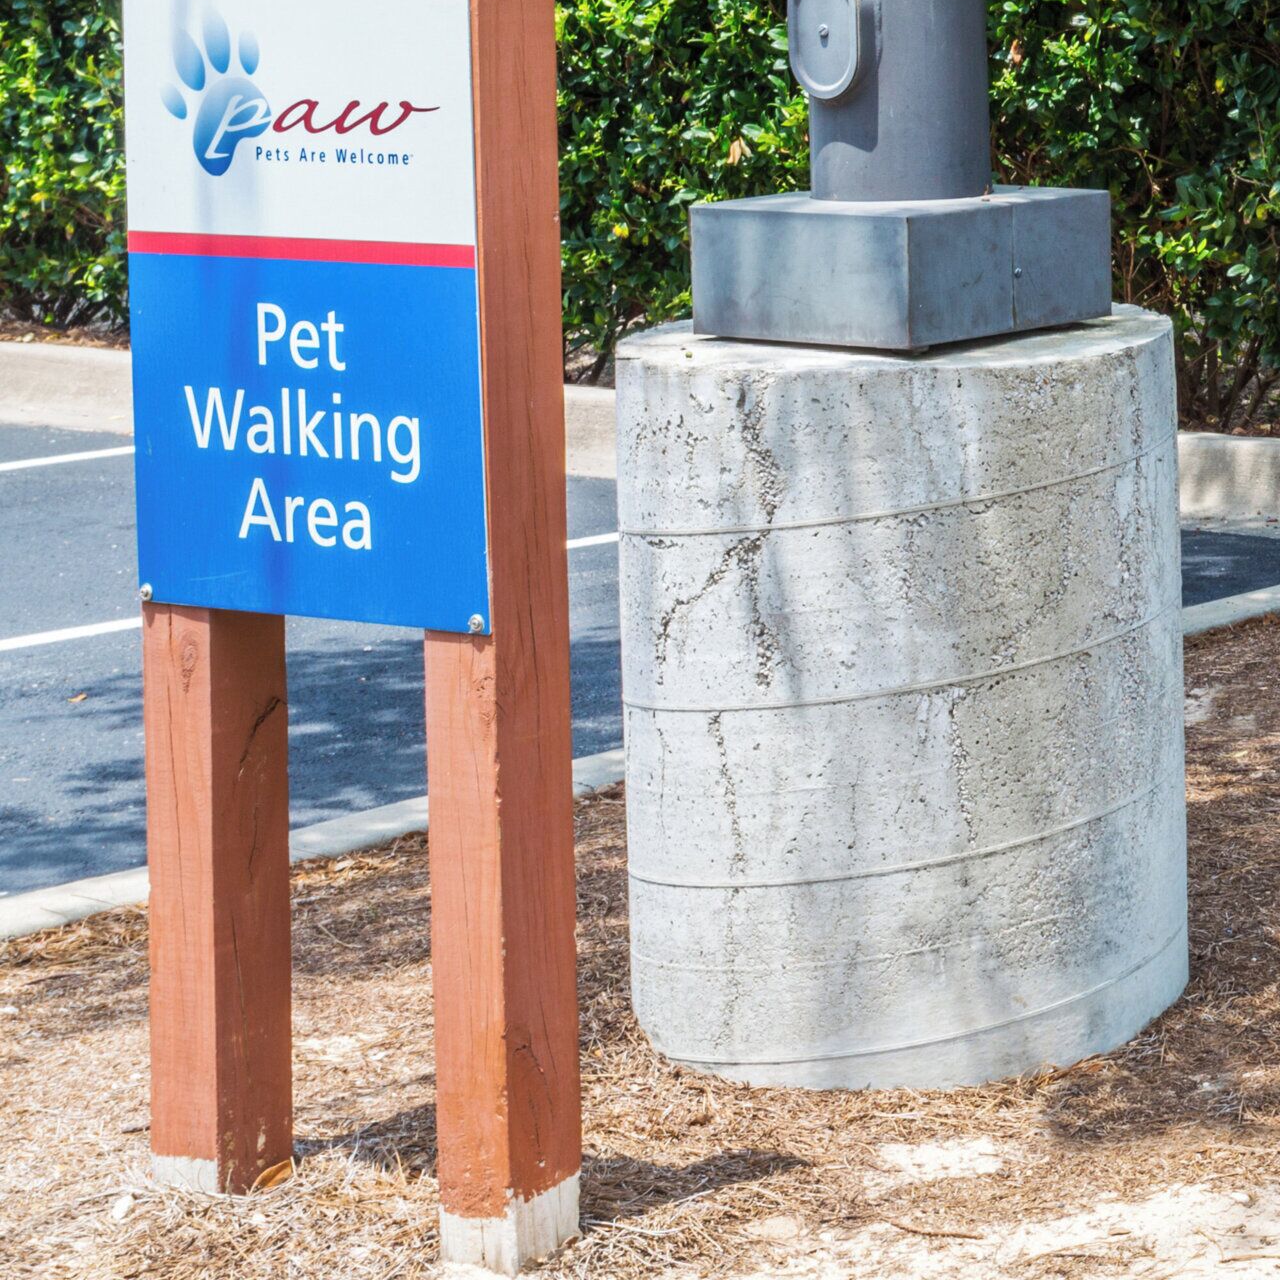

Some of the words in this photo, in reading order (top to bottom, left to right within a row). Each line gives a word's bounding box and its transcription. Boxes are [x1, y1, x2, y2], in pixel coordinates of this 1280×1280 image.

[205, 93, 440, 159] paw
[256, 146, 290, 162] Pets
[300, 147, 326, 163] Are
[336, 149, 410, 166] Welcome
[256, 302, 346, 371] Pet
[184, 385, 421, 483] Walking
[238, 477, 372, 550] Area
